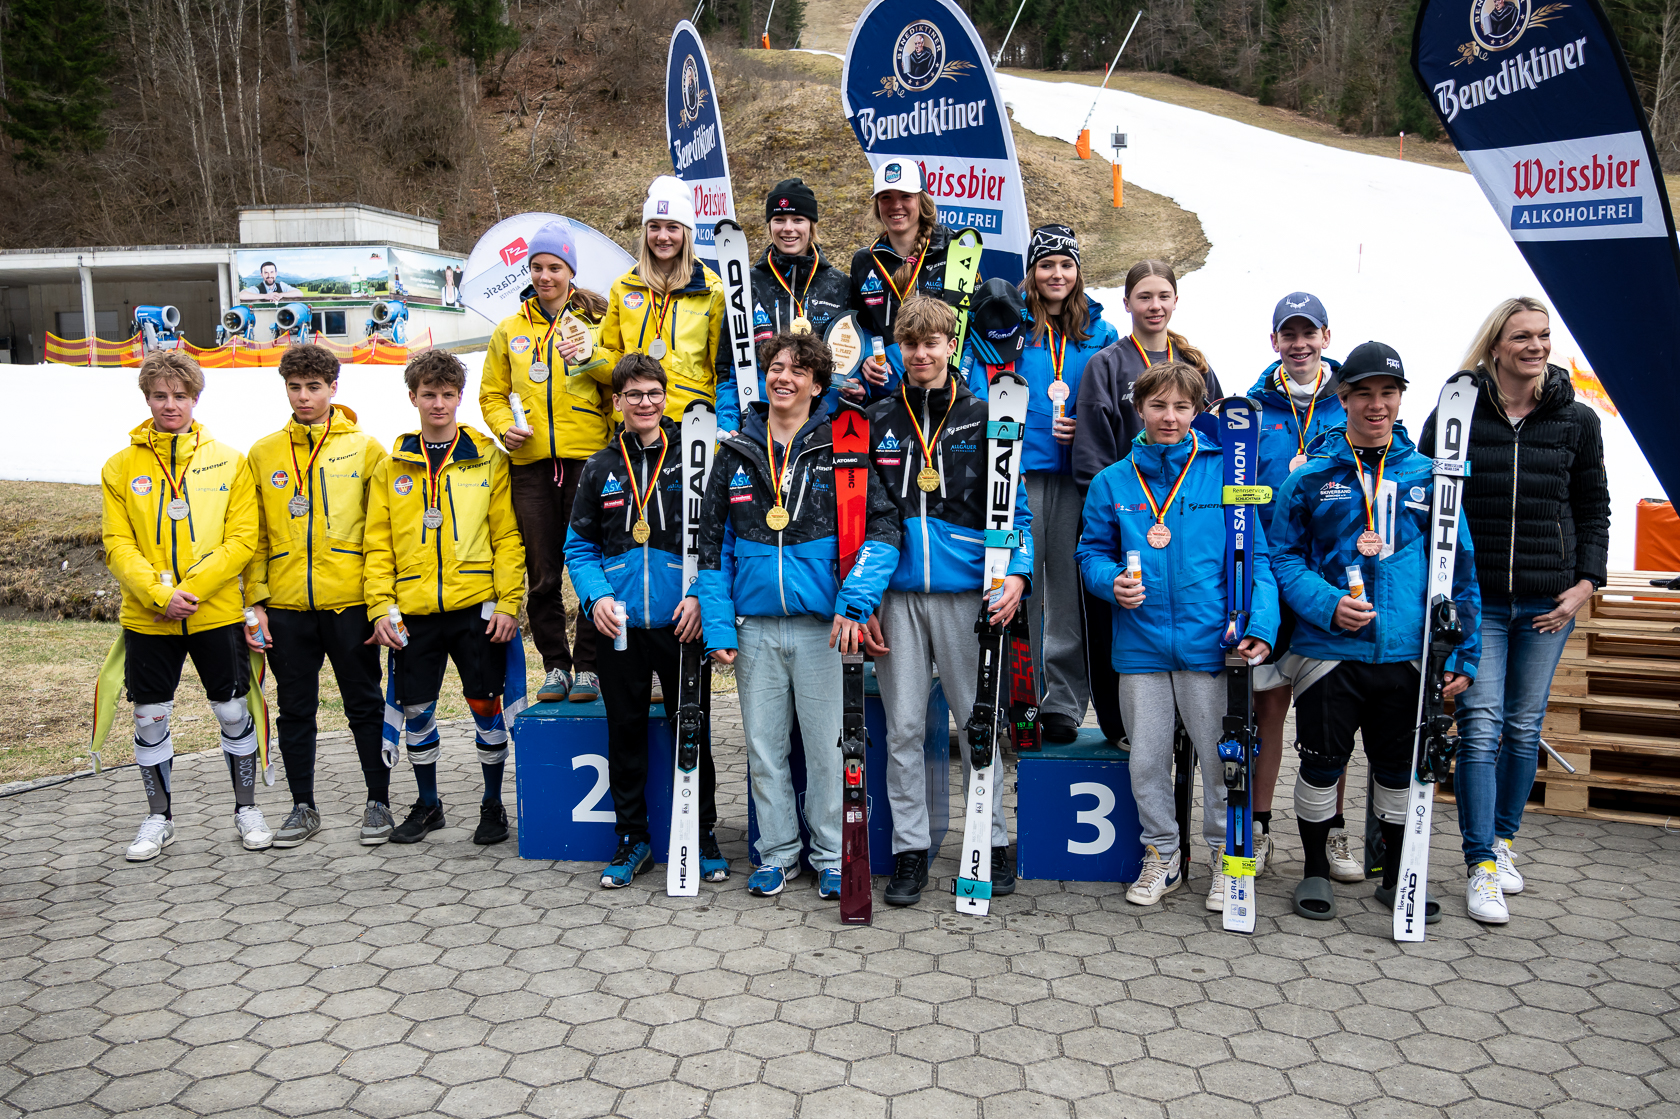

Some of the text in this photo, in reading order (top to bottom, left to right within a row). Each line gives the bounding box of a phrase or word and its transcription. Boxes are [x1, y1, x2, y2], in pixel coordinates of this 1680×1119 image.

[897, 25, 942, 60] BENEDIKTINER
[1434, 37, 1588, 123] Benediktiner
[856, 97, 987, 151] Benediktiner
[915, 160, 1005, 201] eissbier
[1512, 154, 1640, 199] Weissbier
[939, 211, 996, 228] HOLFREI
[1519, 204, 1633, 224] ALKOHOLFREI
[861, 280, 883, 292] ASV
[727, 259, 752, 368] HEAD
[877, 440, 900, 449] ASV
[602, 482, 622, 494] ASV
[730, 475, 750, 486] ASV
[1440, 557, 1447, 569] R
[141, 768, 156, 796] SOCKS
[239, 758, 253, 787] SOCKS
[572, 754, 616, 823] 2
[1068, 782, 1117, 855] 3
[679, 846, 688, 889] HEAD
[1406, 872, 1418, 934] HEAD
